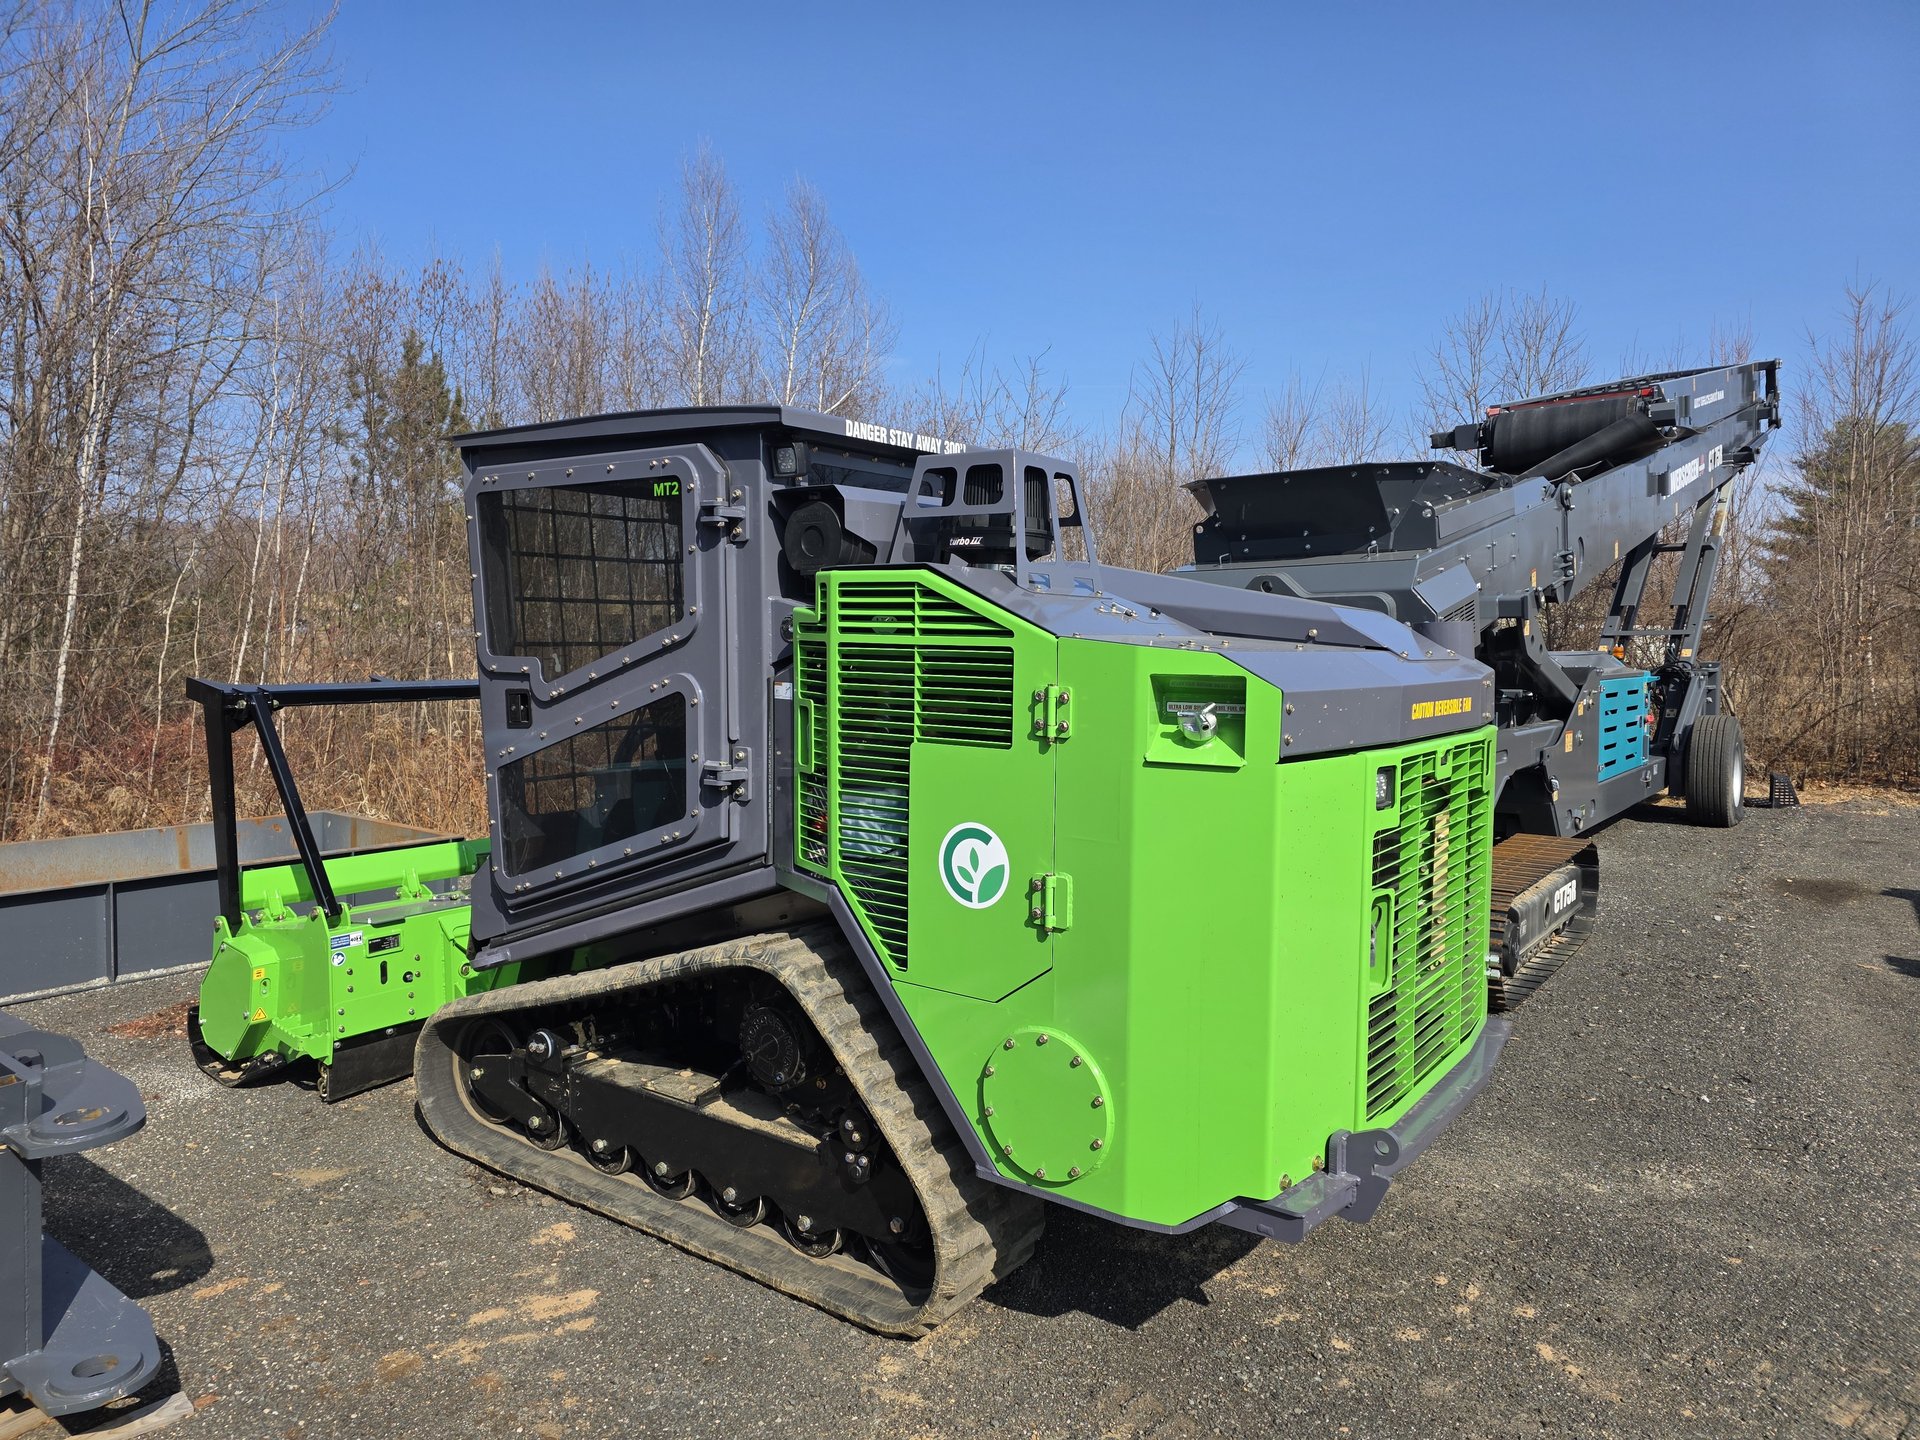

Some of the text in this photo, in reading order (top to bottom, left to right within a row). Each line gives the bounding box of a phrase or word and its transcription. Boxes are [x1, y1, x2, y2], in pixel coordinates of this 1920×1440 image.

[845, 419, 887, 444] DANGER
[889, 428, 914, 449] STAY
[915, 434, 942, 454] AWAY
[653, 481, 680, 497] MT2
[1411, 701, 1435, 720] CAUTION
